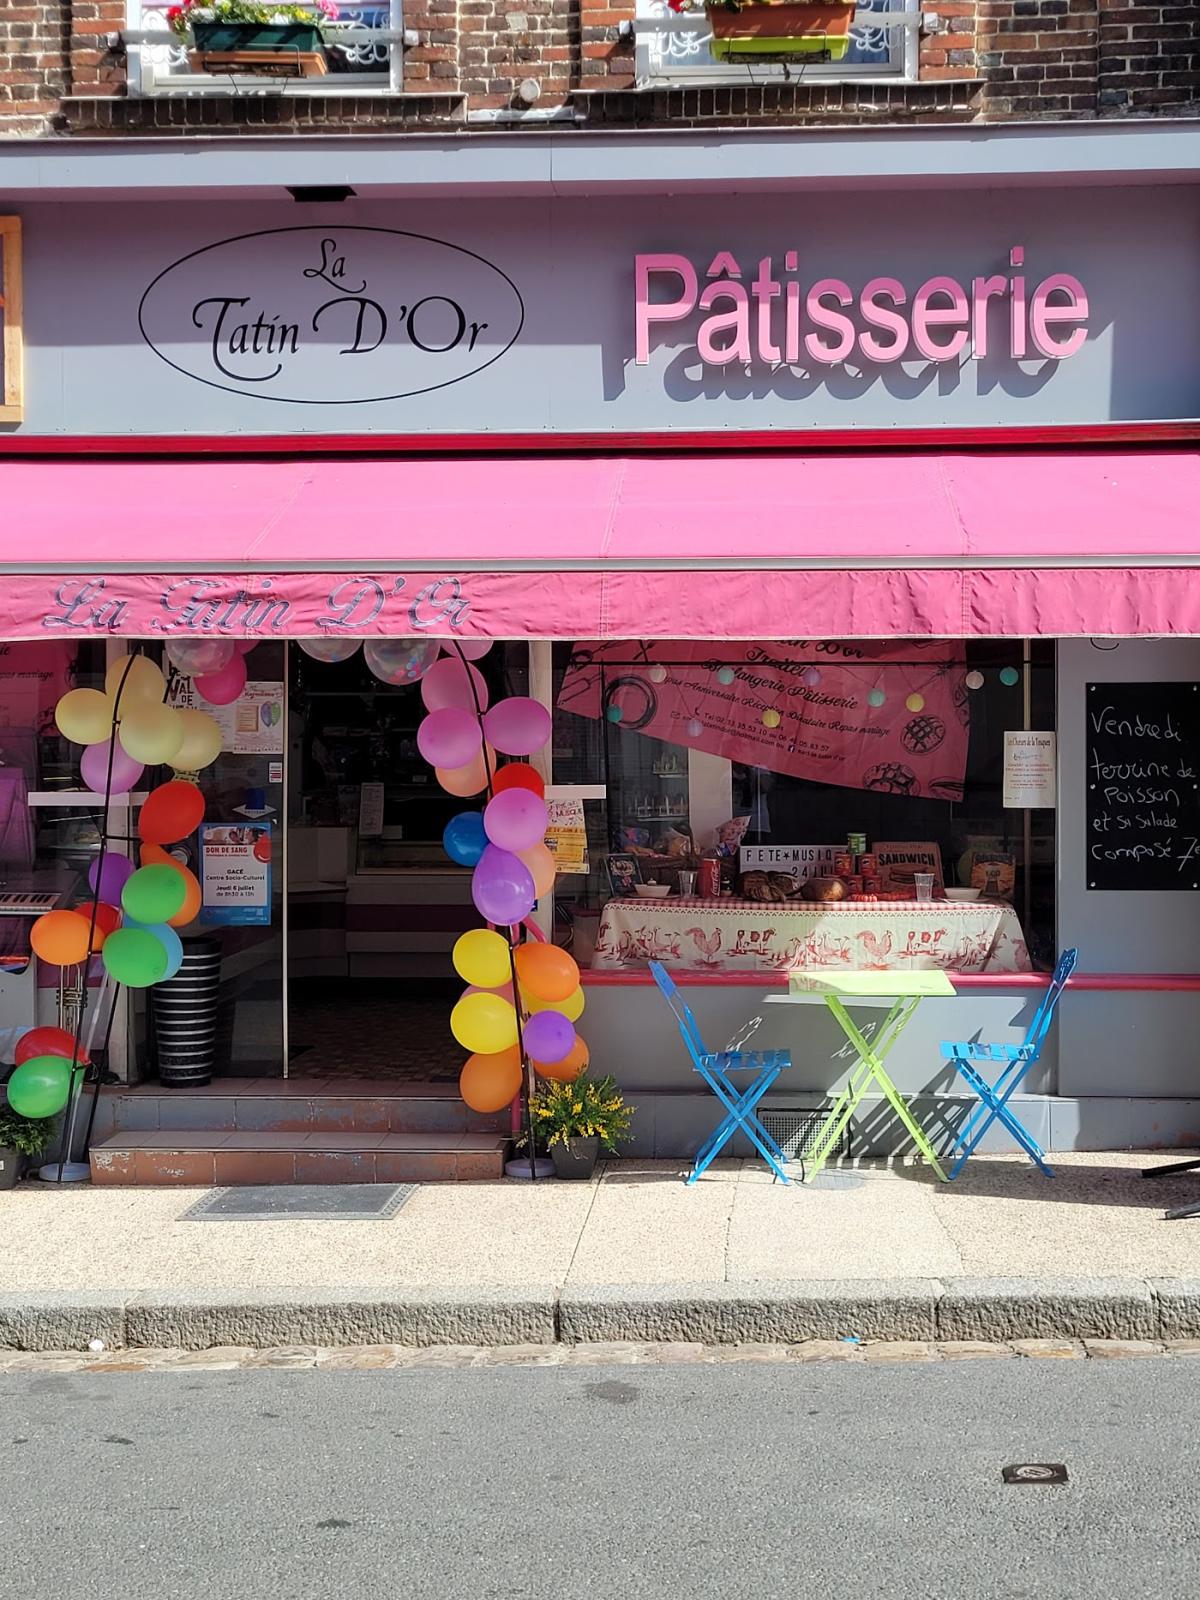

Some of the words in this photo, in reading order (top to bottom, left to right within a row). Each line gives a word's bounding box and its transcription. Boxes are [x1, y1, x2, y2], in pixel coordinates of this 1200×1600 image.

[303, 238, 366, 293] La
[634, 245, 1089, 366] Pâtisserie
[192, 296, 300, 382] Tatin
[312, 295, 488, 355] D'Or
[42, 577, 130, 629] La
[151, 578, 294, 630] Tatin
[181, 695, 193, 706] DE
[787, 686, 859, 710] Pâtisserie
[1091, 706, 1182, 742] Vendredi
[1176, 758, 1197, 778] de
[1103, 786, 1180, 807] Poisson
[1093, 810, 1112, 832] et
[205, 846, 219, 854] DON
[221, 846, 229, 854] DE
[231, 846, 248, 854] SANG
[878, 852, 936, 867] SANDWICH
[791, 865, 808, 878] 24
[237, 885, 255, 893] juillet
